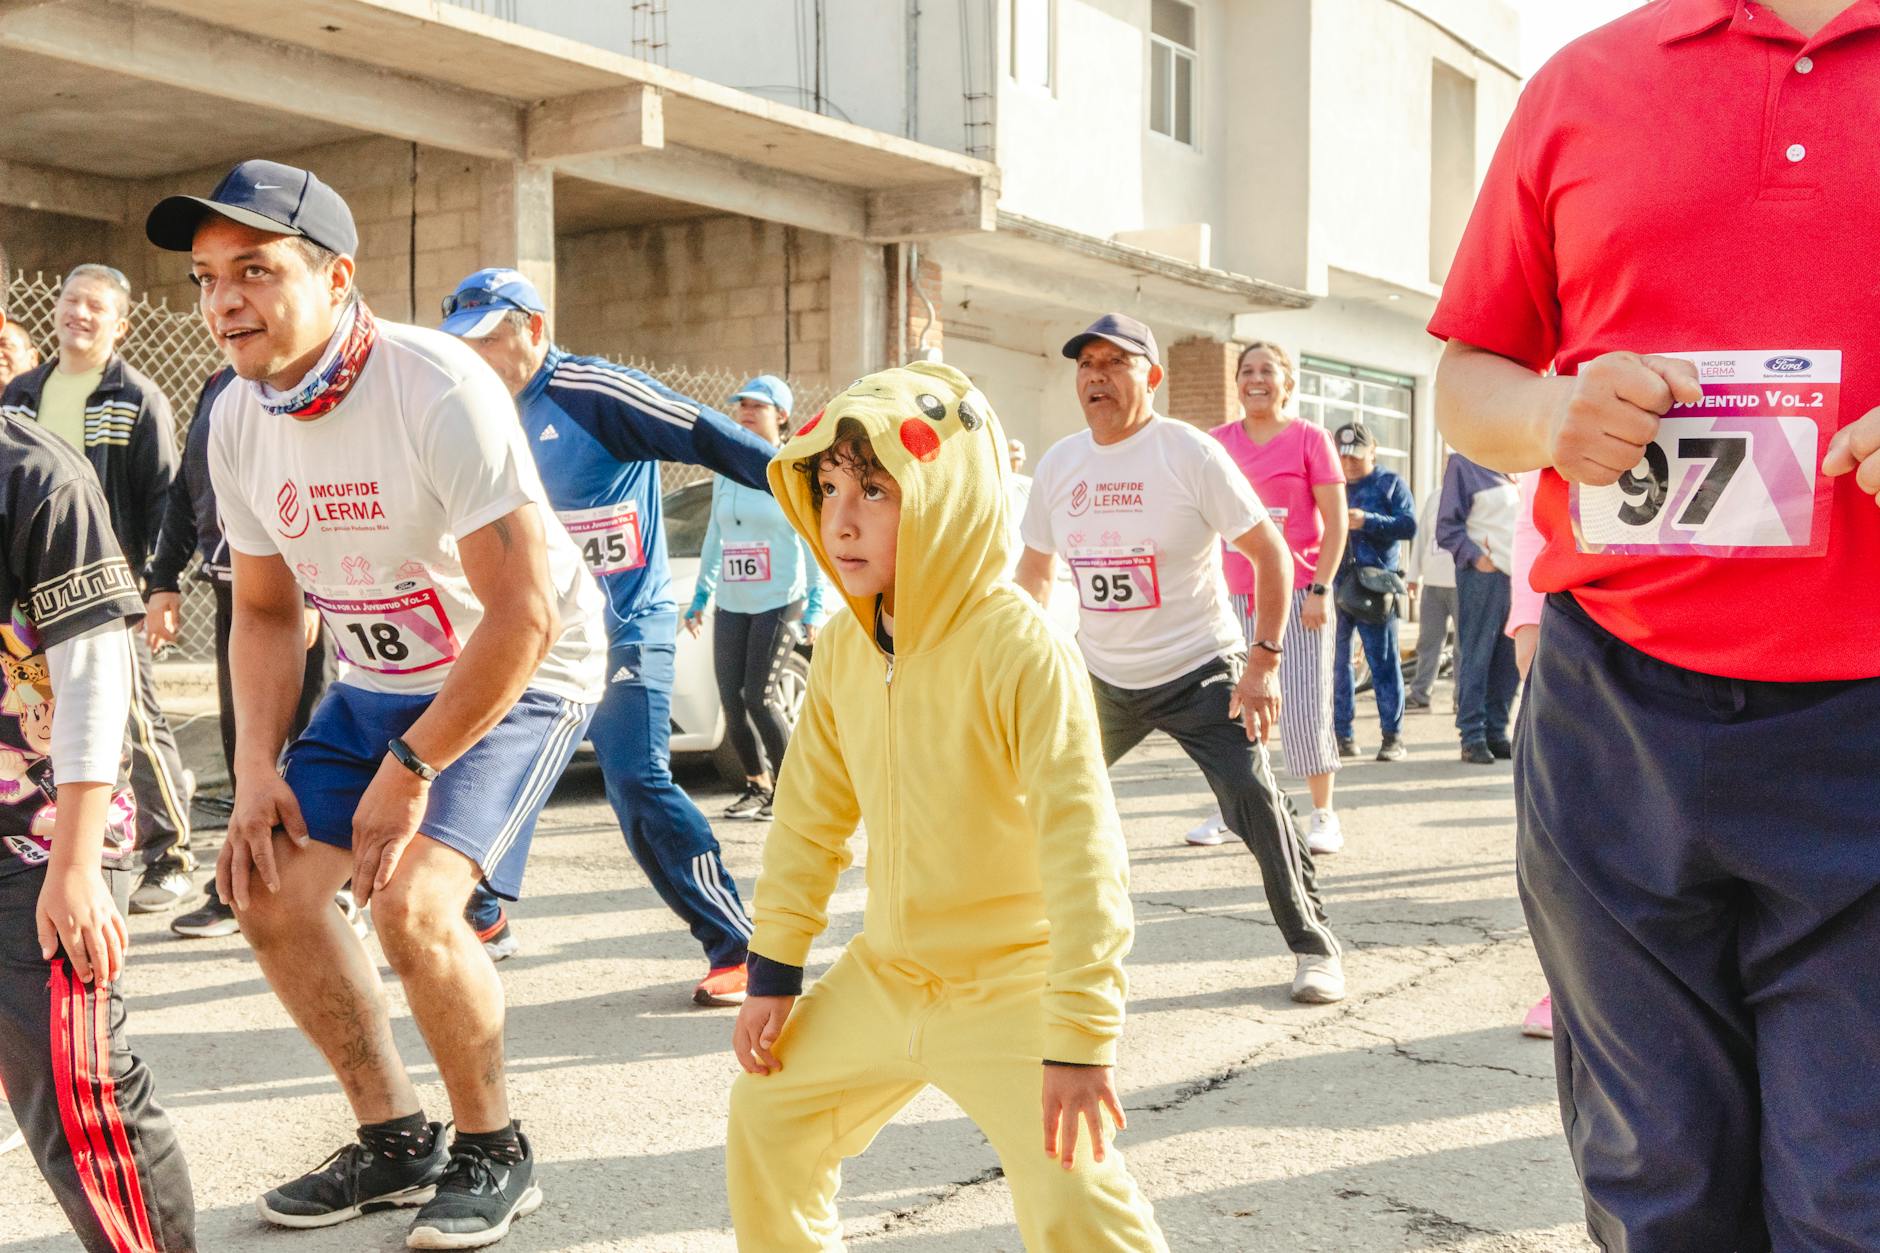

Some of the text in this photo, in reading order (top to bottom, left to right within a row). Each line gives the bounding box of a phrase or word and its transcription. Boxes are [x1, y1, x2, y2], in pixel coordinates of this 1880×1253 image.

[1701, 367, 1736, 376] LERMA
[1772, 358, 1804, 370] Ford
[1765, 390, 1824, 408] VOL.2
[309, 481, 380, 499] IMCUFIDE
[1095, 482, 1144, 492] IMCUFIDE
[1617, 437, 1747, 526] 97
[1094, 494, 1143, 507] LERMA
[313, 501, 385, 522] LERMA
[583, 533, 626, 566] 45
[729, 558, 757, 576] 116
[1092, 574, 1133, 602] 95
[346, 622, 409, 661] 18
